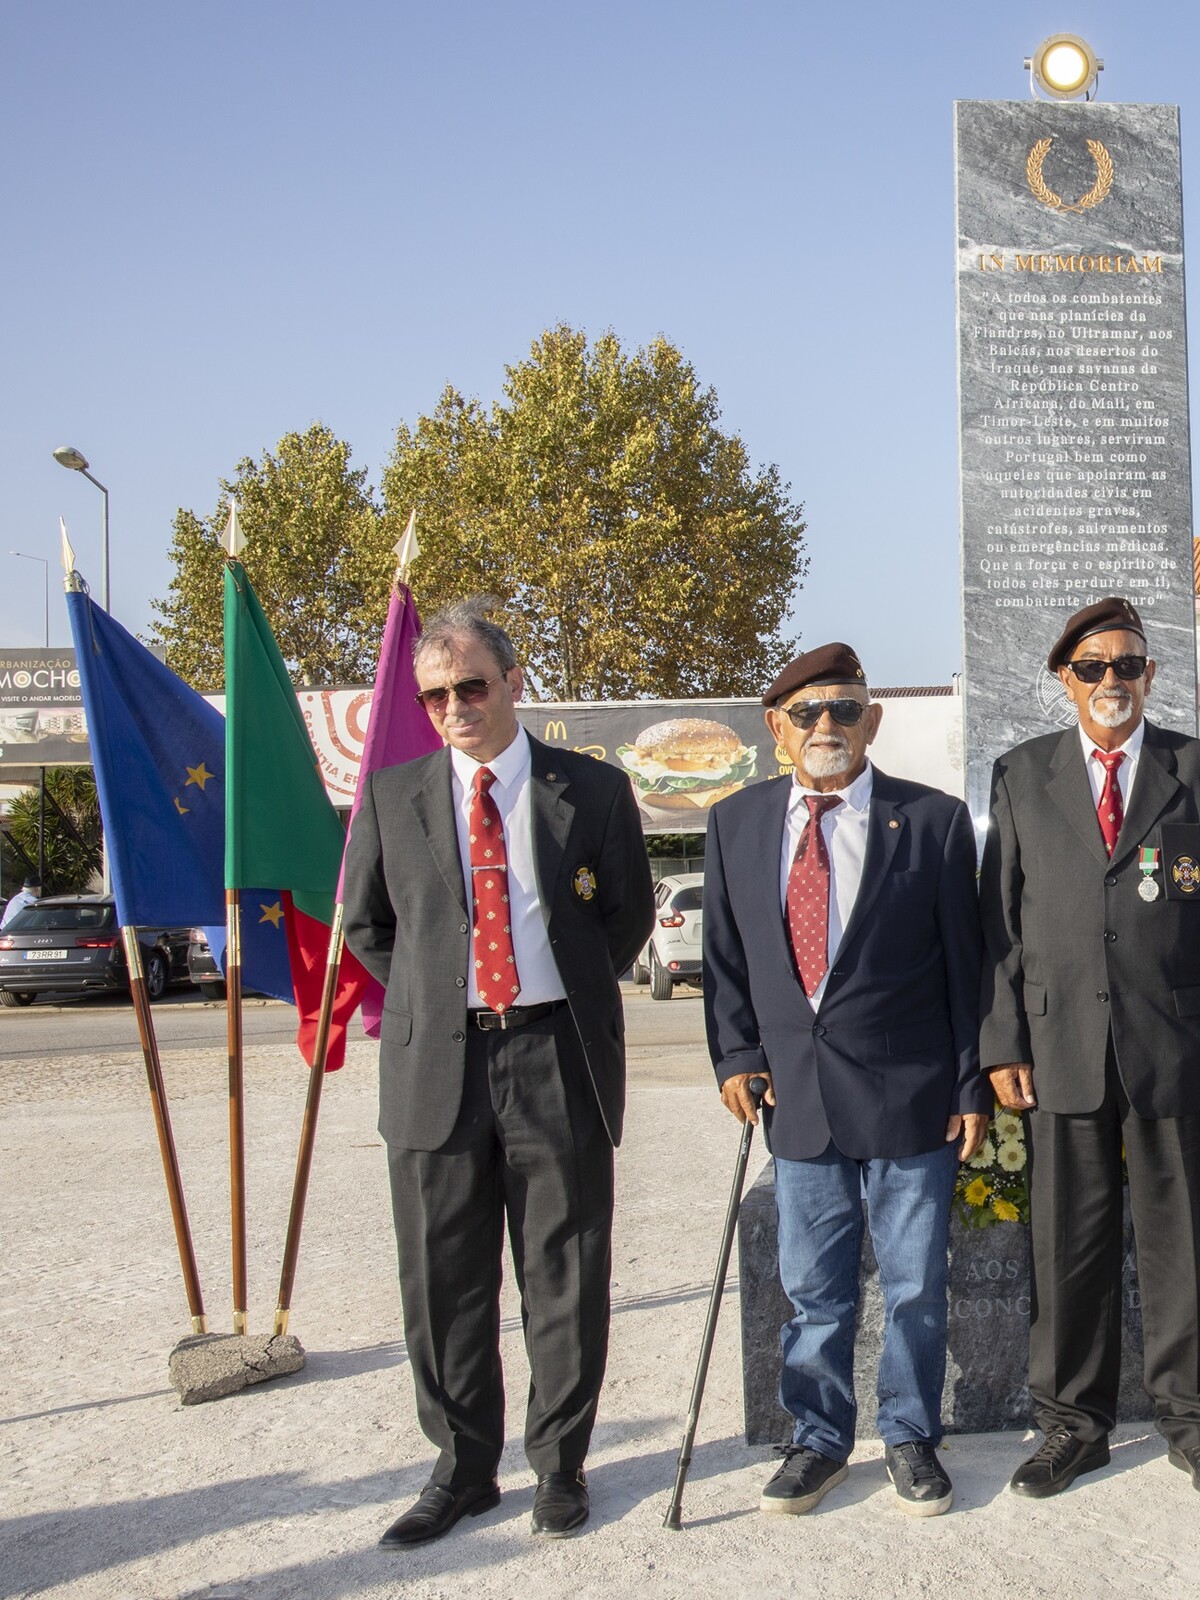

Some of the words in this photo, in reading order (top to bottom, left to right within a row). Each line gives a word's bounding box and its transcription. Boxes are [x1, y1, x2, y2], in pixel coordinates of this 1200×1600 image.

[979, 254, 1005, 272] IN
[1015, 255, 1164, 273] MEMORIAM
[1008, 292, 1047, 304] todos
[1052, 295, 1067, 304] os
[1072, 292, 1162, 305] combatentes
[999, 311, 1025, 324] que
[1029, 311, 1054, 321] nas
[1060, 309, 1124, 324] planícies
[1129, 309, 1146, 322] da
[973, 326, 1043, 341] Flandres,
[1049, 329, 1065, 339] no
[1071, 326, 1144, 341] Ultramar,
[1149, 330, 1173, 340] nos
[989, 345, 1041, 358] Balcãs,
[1047, 346, 1070, 356] nos
[1076, 345, 1136, 356] desertos
[1142, 344, 1158, 357] do
[990, 362, 1044, 376] Iraque,
[1049, 364, 1073, 374] nas
[1078, 364, 1135, 374] savanas
[1141, 363, 1158, 374] da
[1010, 379, 1084, 394] República
[1089, 379, 1139, 392] Centro
[994, 398, 1064, 411] Africana,
[1069, 398, 1086, 410] do
[1091, 398, 1130, 412] Mali,
[1135, 400, 1155, 410] em
[980, 415, 1077, 429] Timor-Leste,
[1082, 417, 1089, 427] e
[1095, 417, 1115, 427] em
[1120, 415, 1169, 427] muitos
[984, 433, 1032, 445] outros
[1036, 433, 1096, 447] lugares,
[1100, 433, 1166, 445] serviram
[1004, 451, 1070, 465] Portugal
[1074, 451, 1104, 463] bem
[1109, 453, 1147, 463] como
[985, 469, 1041, 483] aqueles
[1046, 471, 1072, 483] que
[1077, 469, 1146, 483] apoiaram
[1151, 471, 1167, 481] as
[1000, 487, 1088, 499] autoridades
[1093, 487, 1127, 498] civis
[1131, 488, 1152, 498] em
[1014, 504, 1083, 516] acidentes
[1088, 505, 1141, 519] graves,
[987, 522, 1073, 536] catástrofes,
[1078, 522, 1168, 534] salvamentos
[986, 544, 1004, 553] ou
[1010, 540, 1100, 554] emergências
[1105, 540, 1169, 552] médicas.
[980, 559, 1009, 573] Que
[1014, 562, 1022, 571] a
[1028, 558, 1067, 573] força
[1072, 561, 1079, 570] e
[1085, 561, 1093, 570] o
[1098, 558, 1155, 572] espírito
[1160, 558, 1176, 569] de
[986, 577, 1026, 589] todos
[1032, 577, 1059, 589] eles
[1064, 576, 1123, 590] perdure
[1129, 578, 1149, 587] em
[1155, 576, 1171, 590] ti,
[995, 594, 1080, 607] combatente
[0, 659, 71, 669] RBANIZAÇÃO
[965, 1259, 1020, 1281] AOS
[954, 1296, 1031, 1319] CONC
